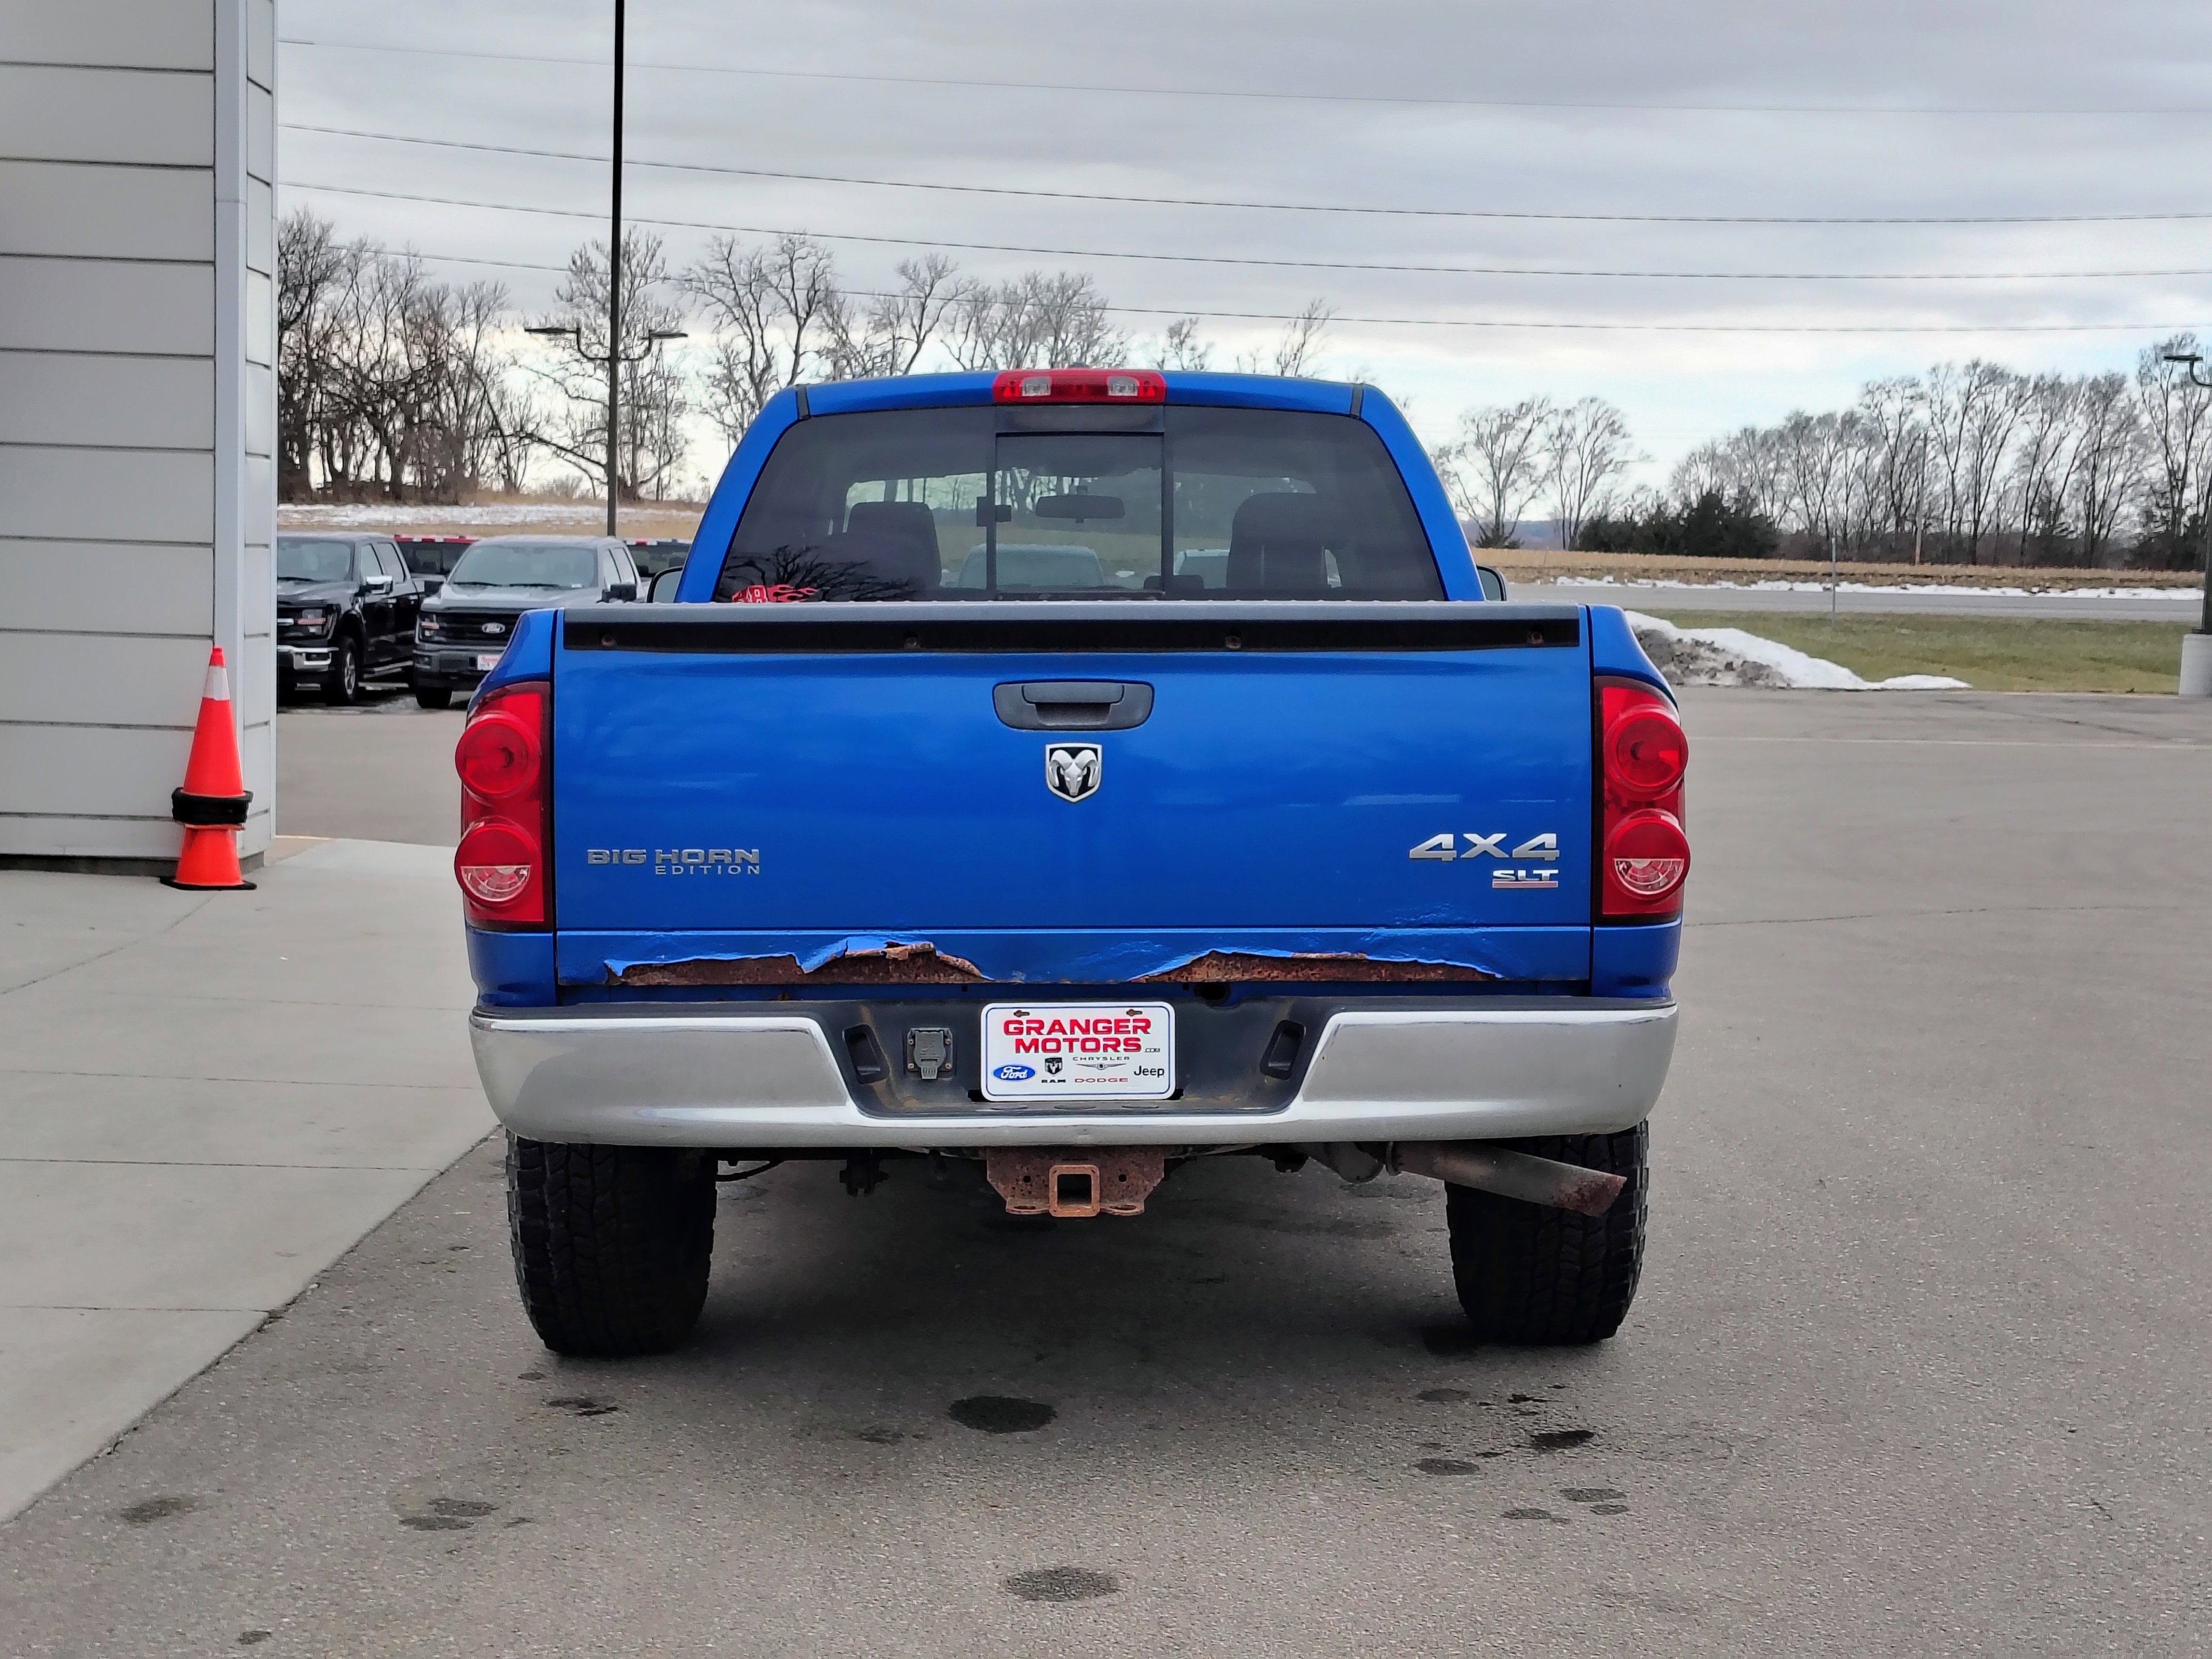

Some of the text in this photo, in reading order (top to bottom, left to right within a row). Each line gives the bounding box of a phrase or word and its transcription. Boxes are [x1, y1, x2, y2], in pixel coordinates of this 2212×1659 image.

[587, 849, 759, 864] BIG HORN
[655, 865, 760, 875] EDITION
[1493, 869, 1559, 881] SLT
[1003, 1019, 1151, 1035] GRANGER
[1015, 1037, 1142, 1054] MOTORS
[1000, 1066, 1028, 1079] Ford
[1134, 1065, 1165, 1078] Jeep
